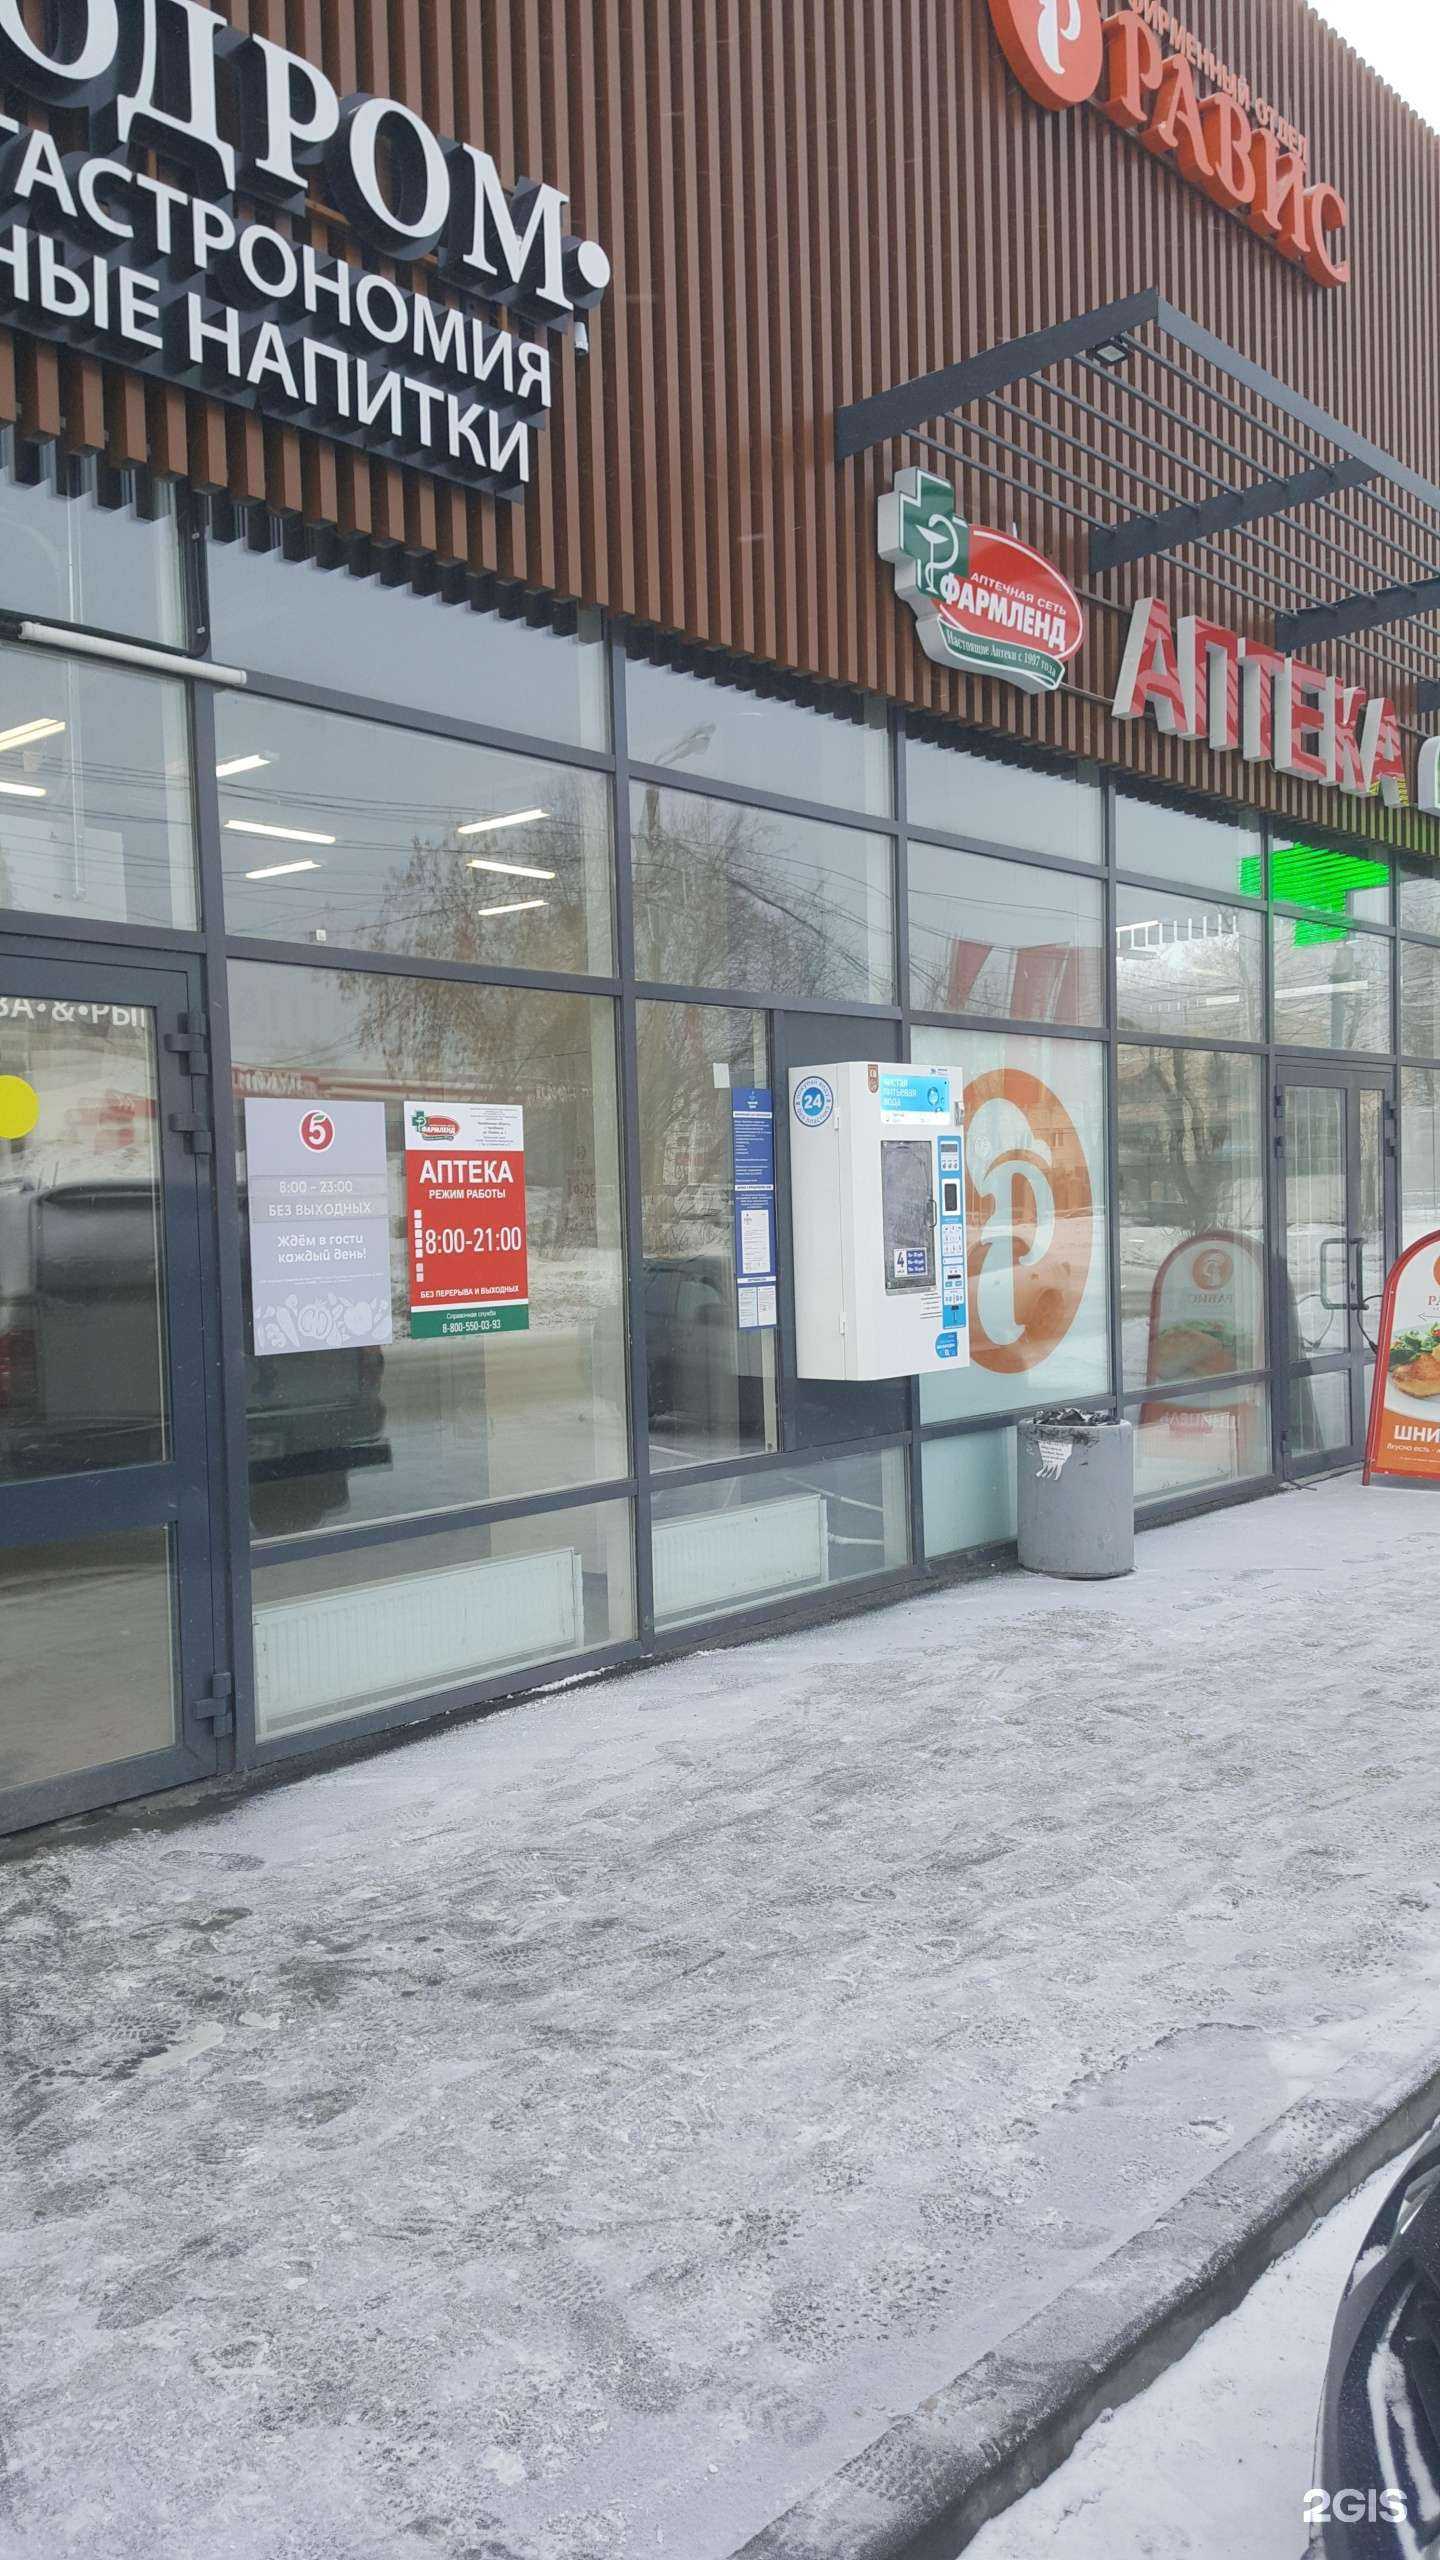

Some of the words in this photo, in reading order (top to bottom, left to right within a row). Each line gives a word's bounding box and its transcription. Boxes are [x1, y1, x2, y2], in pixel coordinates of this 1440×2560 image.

[1116, 9, 1350, 283] РАВИС
[0, 113, 552, 408] АСТРОНОМИЯ
[189, 290, 530, 483] НАПИТКИ
[970, 572, 1035, 604] АПТЕЧНАЯ
[1036, 598, 1067, 616] СЕТЬ
[939, 572, 1066, 652] ФАРМЛЕНД
[946, 629, 990, 656] Настоящие
[990, 643, 1017, 661] Аптеки
[1024, 651, 1040, 667] 1997
[1041, 660, 1057, 678] года
[1113, 597, 1410, 807] АПТЕКА
[803, 1093, 823, 1110] 24
[419, 1159, 514, 1183] АПТЕКА
[279, 1181, 307, 1194] 8:00
[319, 1180, 353, 1193] 23:00
[428, 1189, 465, 1199] РЕЖИМ
[466, 1188, 506, 1199] РАБОТЫ
[268, 1204, 292, 1217] БЕЗ
[295, 1202, 373, 1217] ВЫХОДНЫХ
[277, 1234, 316, 1248] Ждём
[319, 1237, 327, 1246] в
[329, 1234, 364, 1245] гости
[425, 1226, 522, 1254] 8:00-21:00
[277, 1251, 331, 1264] каждый
[334, 1248, 367, 1261] день!
[896, 1251, 905, 1268] 4
[420, 1290, 435, 1299] БЕЗ
[435, 1287, 474, 1297] ПЕРЕРЫВА
[480, 1284, 520, 1294] ВЫХОДНЫХ
[442, 1319, 501, 1334] 8-800-550-03-93
